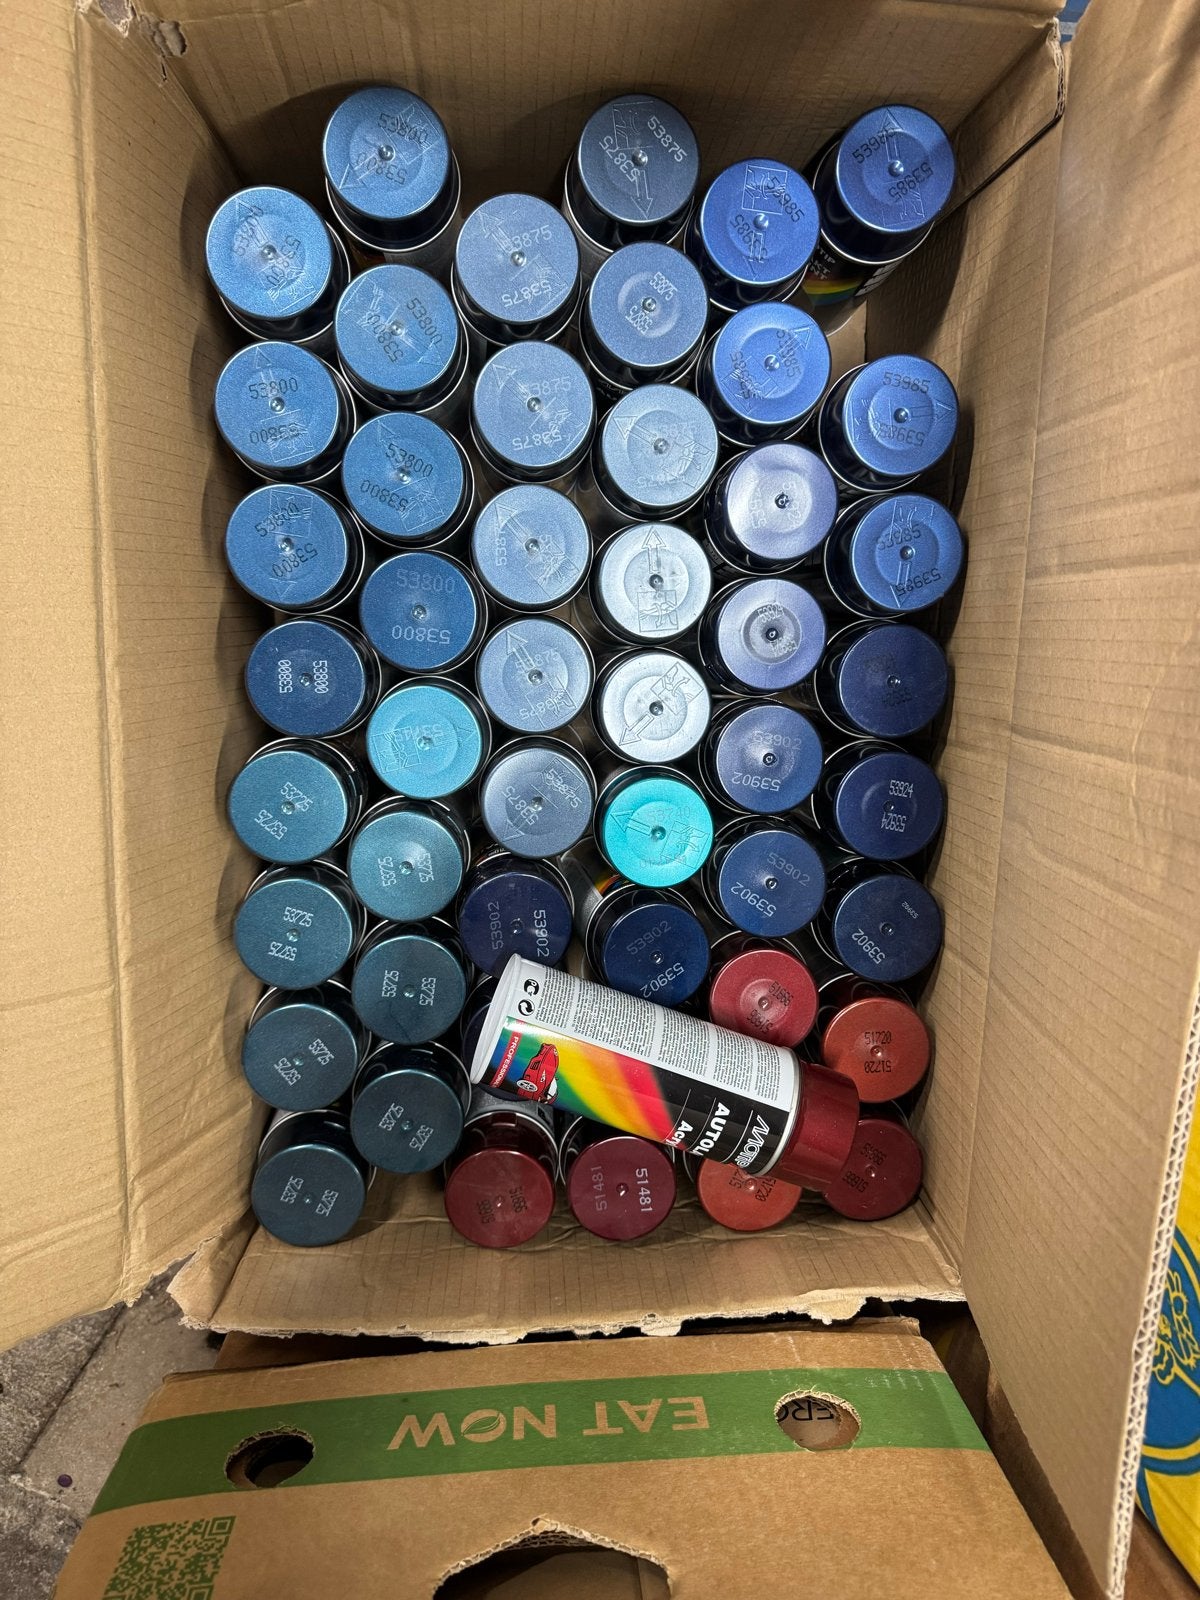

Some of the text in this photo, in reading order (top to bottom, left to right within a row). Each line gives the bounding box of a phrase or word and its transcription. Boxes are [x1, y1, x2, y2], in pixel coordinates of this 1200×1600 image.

[377, 112, 429, 143] 53800
[647, 116, 688, 163] 53875
[356, 152, 407, 185] 53800
[599, 135, 640, 183] 53875
[888, 162, 934, 203] 53985
[503, 224, 552, 252] 53875
[502, 280, 552, 308] 53875
[650, 272, 678, 301] 53875
[406, 297, 443, 346] 53800
[625, 306, 653, 336] 53875
[248, 377, 298, 400] 53800
[883, 372, 931, 394] 53985
[384, 443, 434, 477] 53800
[360, 479, 409, 515] 53800
[255, 502, 302, 538] 53800
[272, 543, 318, 578] 53800
[396, 569, 455, 593] 53800
[392, 625, 451, 645] 53800
[278, 659, 293, 694] 53800
[313, 660, 329, 694] 53800
[752, 731, 802, 750] 53902
[732, 772, 781, 791] 53902
[889, 780, 914, 798] 53924
[280, 782, 313, 812] 53725
[502, 785, 538, 826] 53875
[254, 810, 288, 840] 53725
[881, 813, 907, 832] 53924
[378, 857, 397, 887] 53725
[419, 853, 435, 883] 53725
[767, 852, 810, 886] 53902
[731, 882, 777, 917] 53902
[283, 907, 314, 927] 53725
[488, 901, 503, 950] 53902
[534, 910, 549, 957] 53902
[626, 920, 671, 955] 53902
[852, 929, 885, 964] 53902
[268, 941, 298, 961] 53725
[382, 970, 399, 998] 53725
[419, 977, 436, 1006] 53725
[641, 962, 684, 998] 53902
[308, 1039, 335, 1065] 53725
[864, 1031, 892, 1045] 51720
[274, 1057, 302, 1086] 53725
[864, 1061, 891, 1074] 51720
[379, 1103, 404, 1131] 53725
[409, 1124, 434, 1151] 53725
[734, 1114, 770, 1168] MOTIP
[280, 1176, 304, 1204] 53725
[591, 1166, 607, 1211] 51481
[636, 1168, 653, 1213] 51481
[729, 1169, 743, 1189] 517
[316, 1189, 339, 1216] 53725
[386, 1396, 710, 1450] EAT NOW
